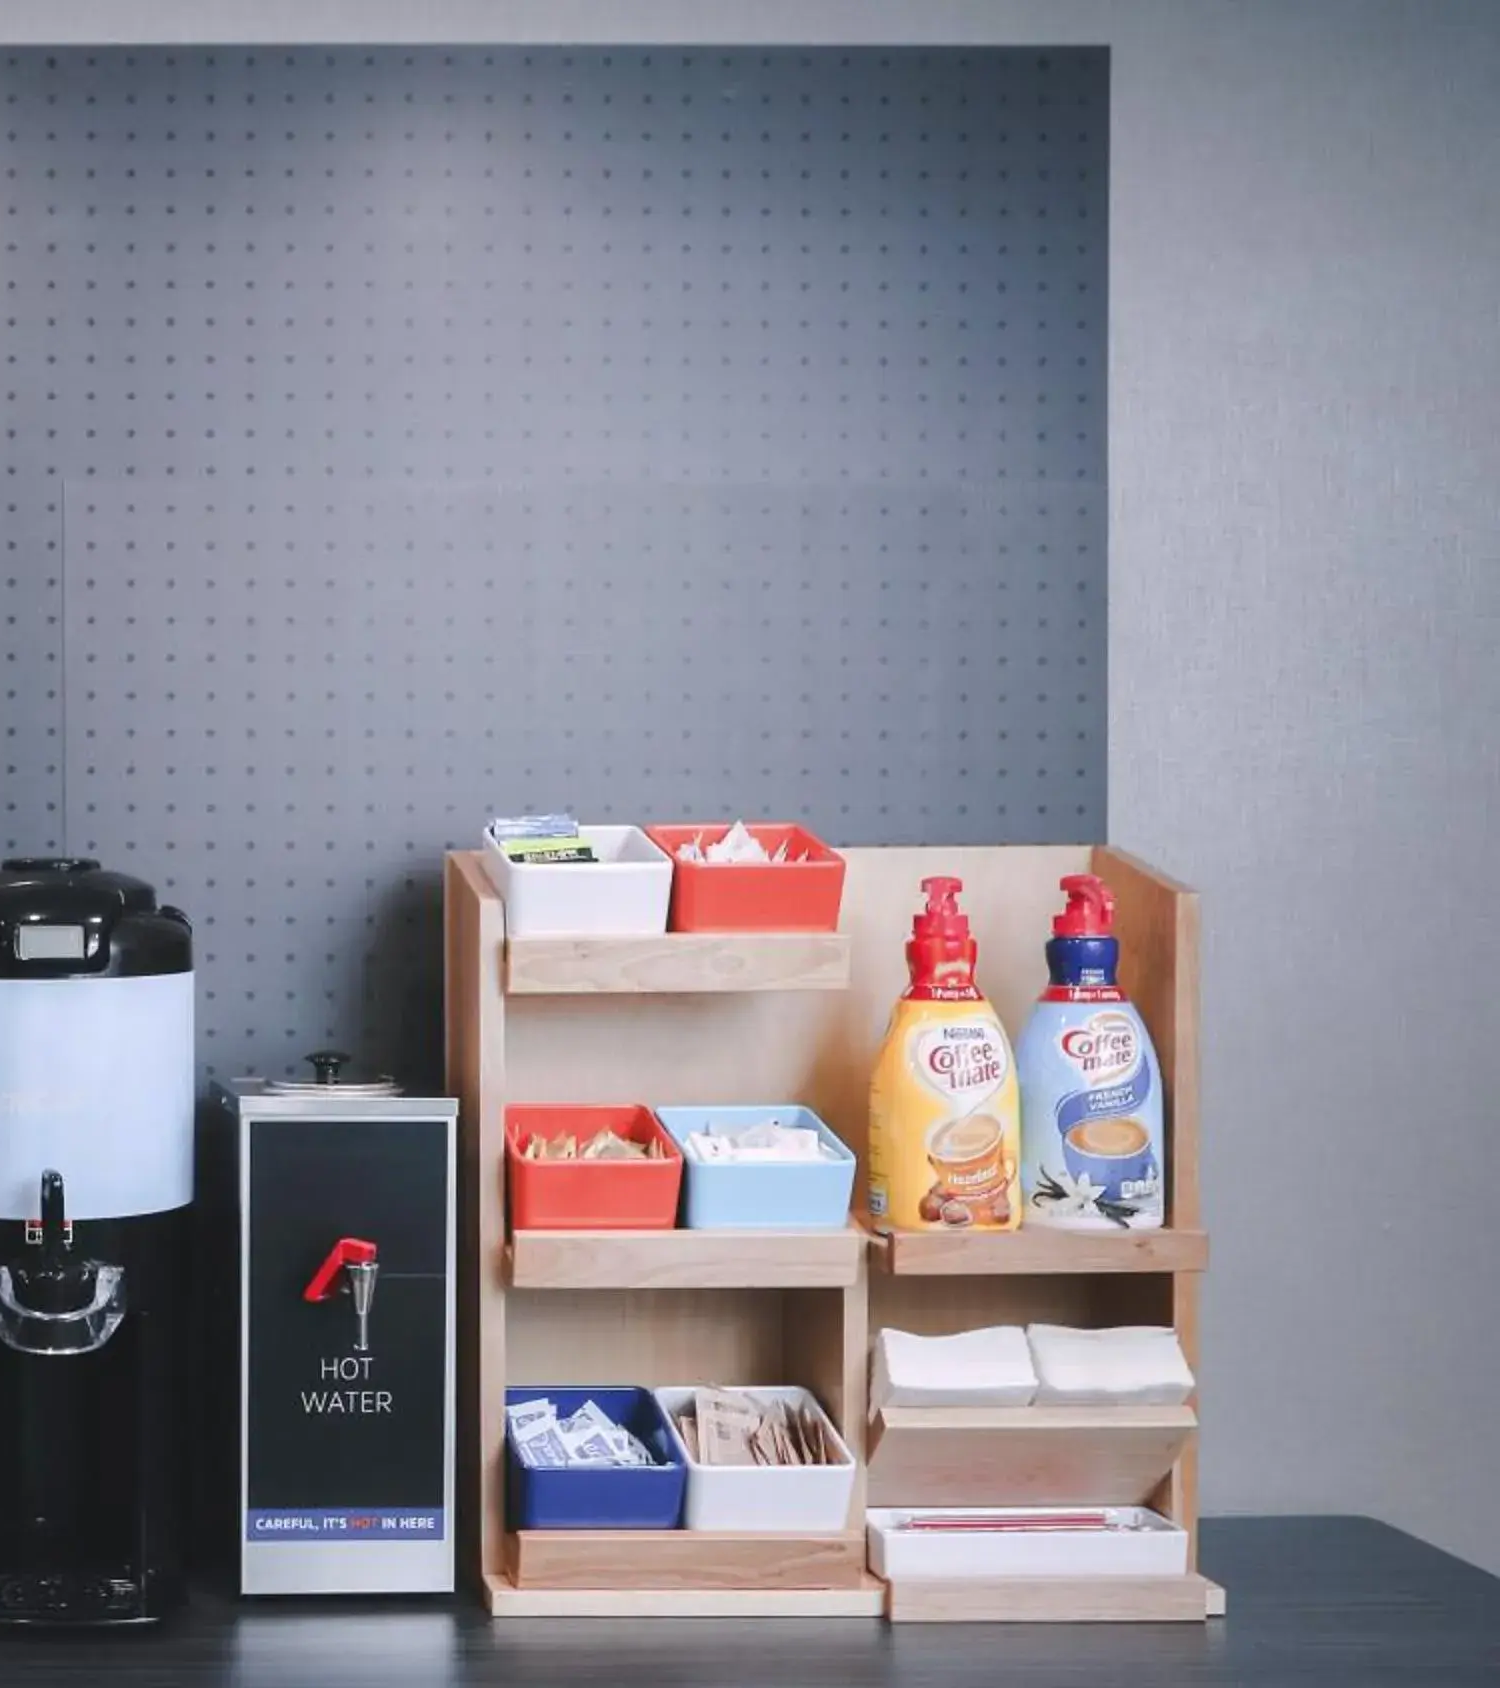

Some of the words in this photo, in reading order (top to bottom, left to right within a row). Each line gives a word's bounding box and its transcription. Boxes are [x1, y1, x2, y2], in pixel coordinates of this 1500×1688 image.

[320, 1357, 374, 1381] HOT
[301, 1391, 394, 1414] WATER
[256, 1518, 319, 1531] CAREFUL,
[323, 1518, 347, 1529] IT'S
[352, 1518, 378, 1529] HOT
[382, 1518, 396, 1529] IN
[400, 1518, 435, 1529] HERE
